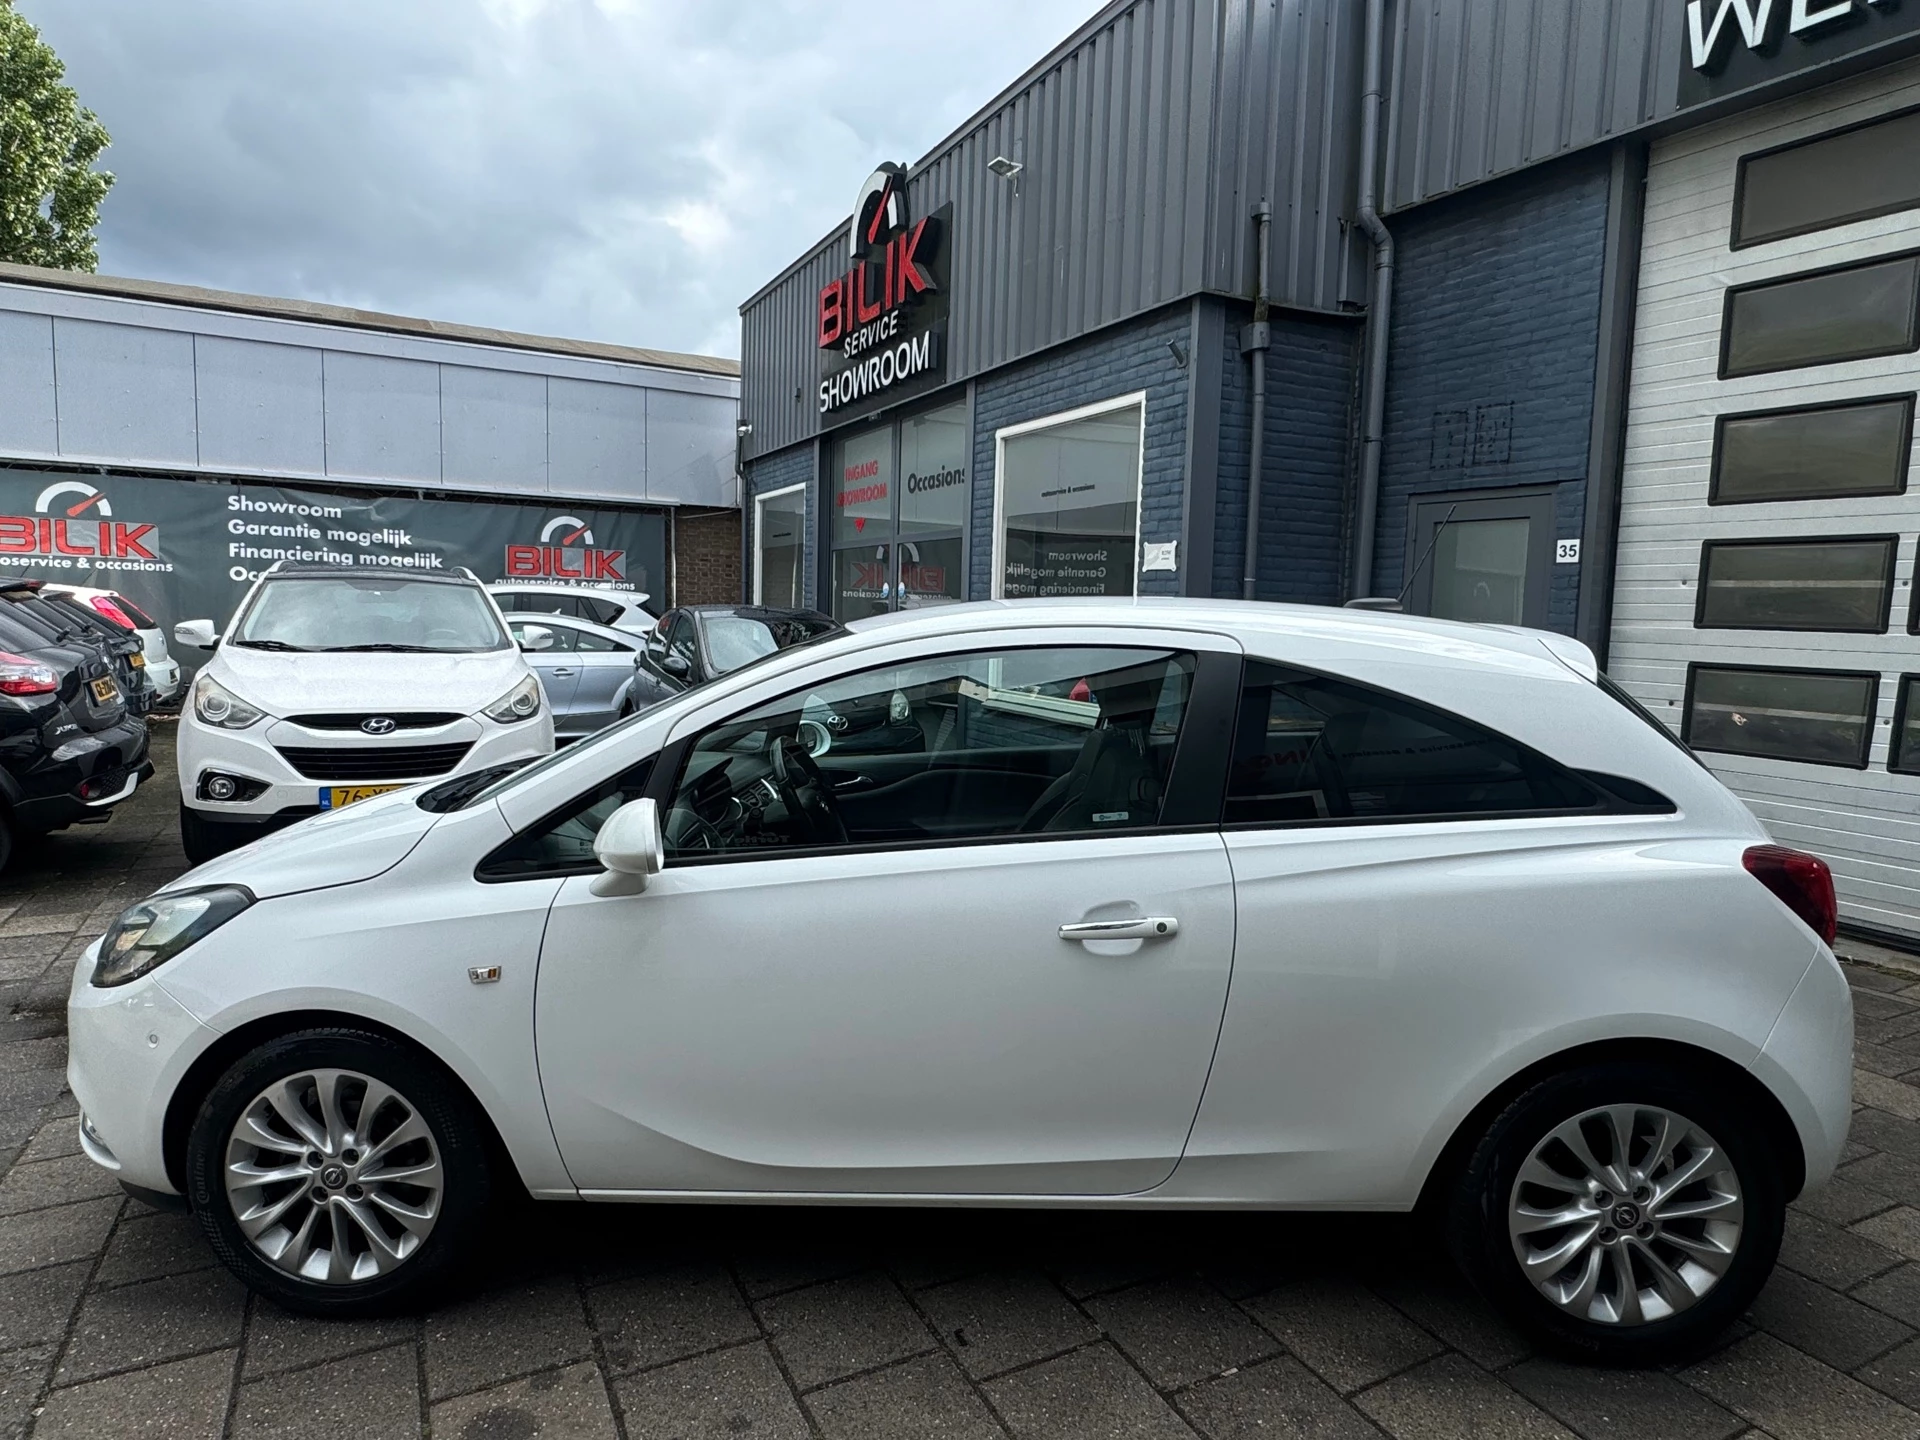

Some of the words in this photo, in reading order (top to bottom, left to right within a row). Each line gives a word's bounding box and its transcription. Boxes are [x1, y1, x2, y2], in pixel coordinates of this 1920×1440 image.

[819, 216, 929, 349] BILIK
[843, 310, 899, 359] SERVICE
[818, 331, 930, 412] SHOWROOM
[845, 460, 878, 482] INGANG
[228, 495, 342, 518] Showroom
[837, 483, 887, 507] SHOWROOM
[0, 516, 158, 559] BILIK
[228, 519, 321, 539] Garantie
[327, 529, 412, 548] mogelijk
[76, 557, 91, 569] &
[95, 559, 173, 572] occasions
[229, 542, 354, 566] Financiering
[359, 552, 443, 570] mogelijk
[507, 545, 625, 580] BILIK
[1558, 545, 1577, 558] 35
[568, 579, 577, 587] &
